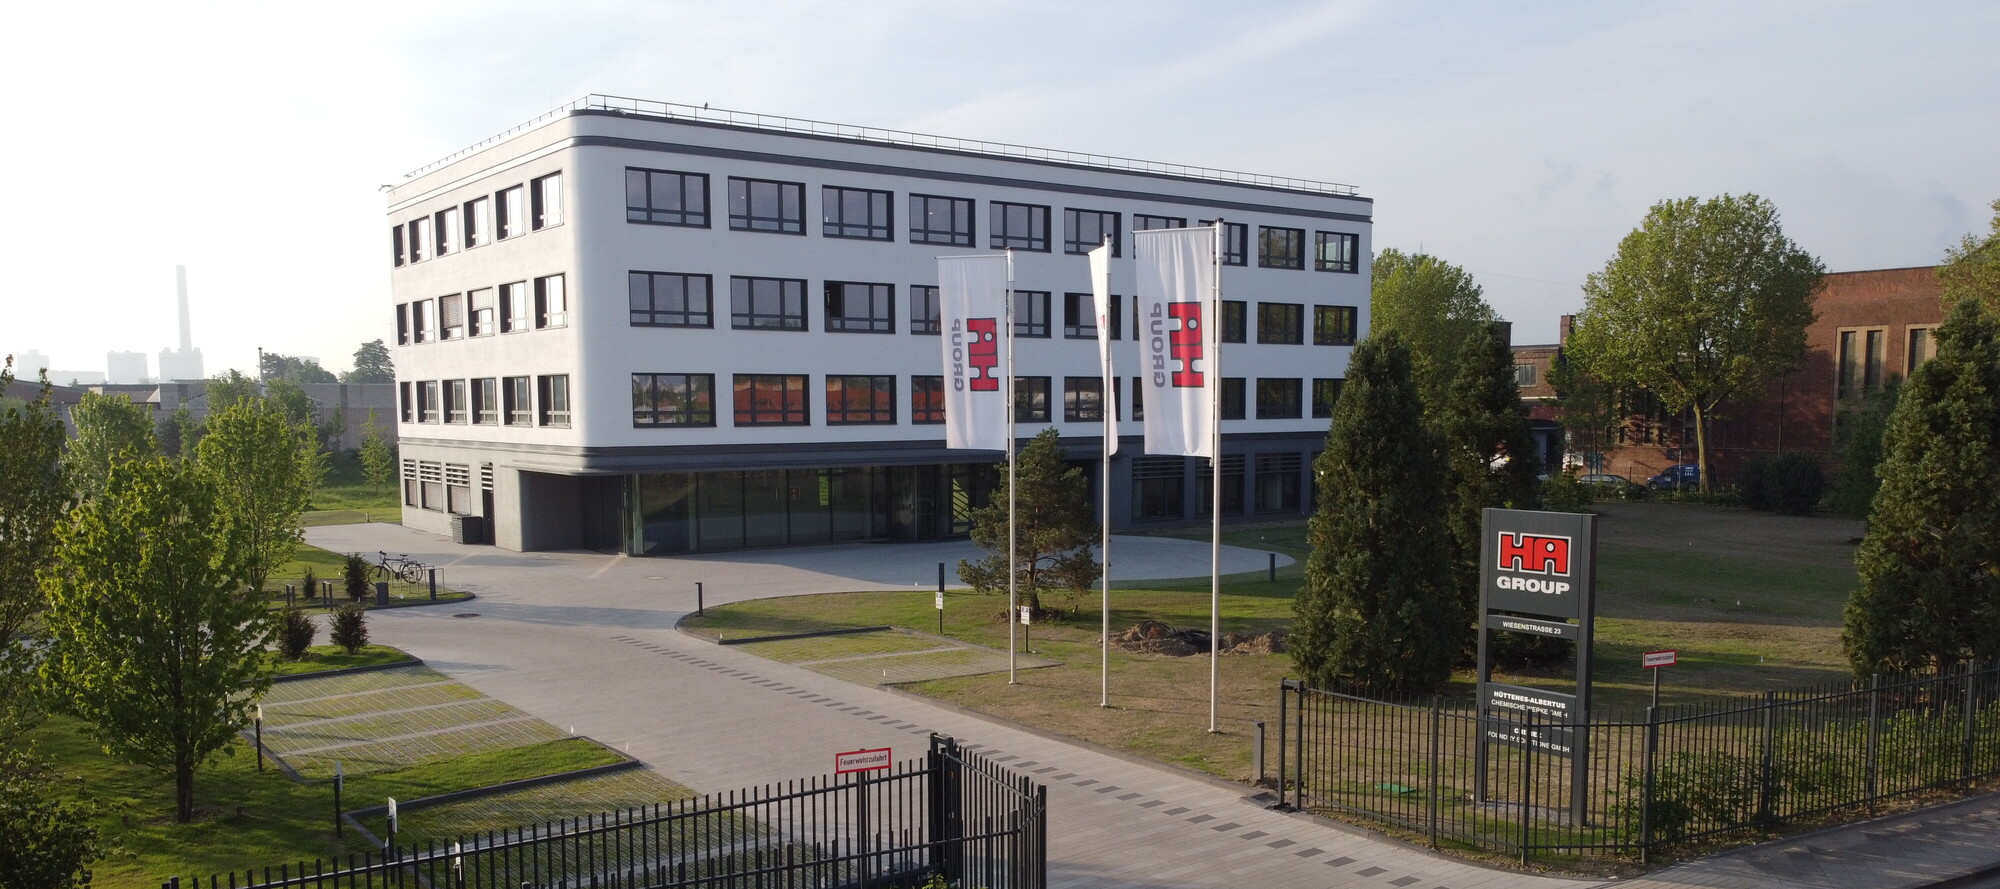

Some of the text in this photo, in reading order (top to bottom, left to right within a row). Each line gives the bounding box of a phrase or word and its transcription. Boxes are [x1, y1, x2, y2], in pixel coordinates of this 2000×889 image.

[1497, 531, 1571, 577] HA
[1496, 575, 1570, 595] GROUP
[1502, 621, 1562, 635] WIESENSTRASSE 23
[1491, 699, 1526, 711] CHEMISCHE
[840, 754, 887, 766] Feuerwehrzufahrt
